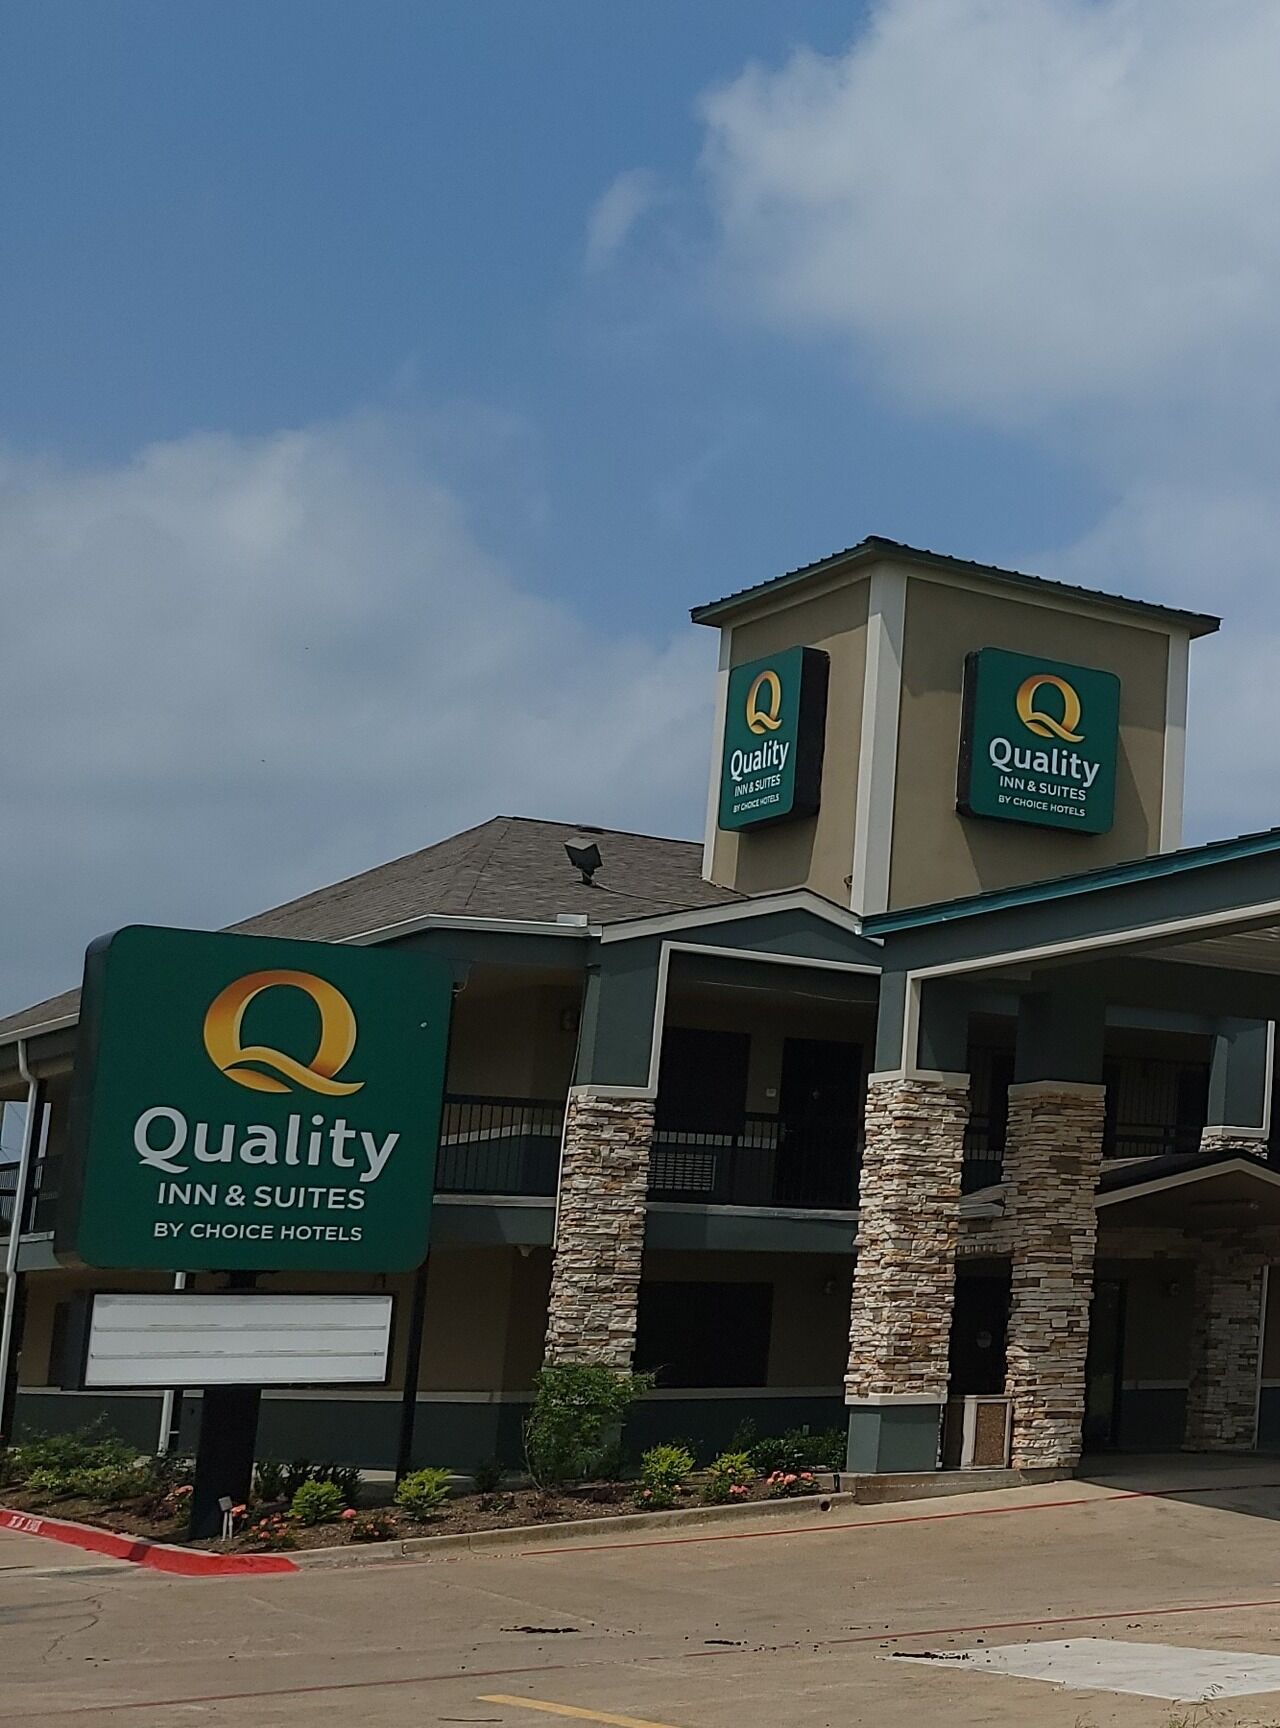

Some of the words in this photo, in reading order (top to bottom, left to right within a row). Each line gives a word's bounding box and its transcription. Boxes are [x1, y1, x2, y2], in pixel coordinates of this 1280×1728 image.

[746, 670, 782, 734] Q
[1016, 674, 1085, 742] Q
[730, 740, 789, 782] Quality
[989, 737, 1100, 788] Quality
[733, 803, 741, 813] BY
[740, 798, 759, 811] CHOICE
[760, 793, 779, 806] HOTELS
[734, 782, 749, 797] INN
[748, 781, 755, 793] &
[754, 774, 781, 790] SUITES
[999, 775, 1025, 790] INN
[1027, 780, 1037, 792] &
[1039, 783, 1086, 800] SUITES
[998, 795, 1011, 803] BY
[1013, 797, 1048, 811] CHOICE
[1050, 803, 1085, 817] HOTELS
[203, 969, 365, 1096] Q
[133, 1106, 400, 1183] Quality
[158, 1182, 217, 1206] INN
[224, 1185, 247, 1207] &
[253, 1185, 366, 1210] SUITES
[153, 1222, 184, 1238] BY
[190, 1223, 274, 1240] CHOICE
[280, 1225, 362, 1242] HOTELS
